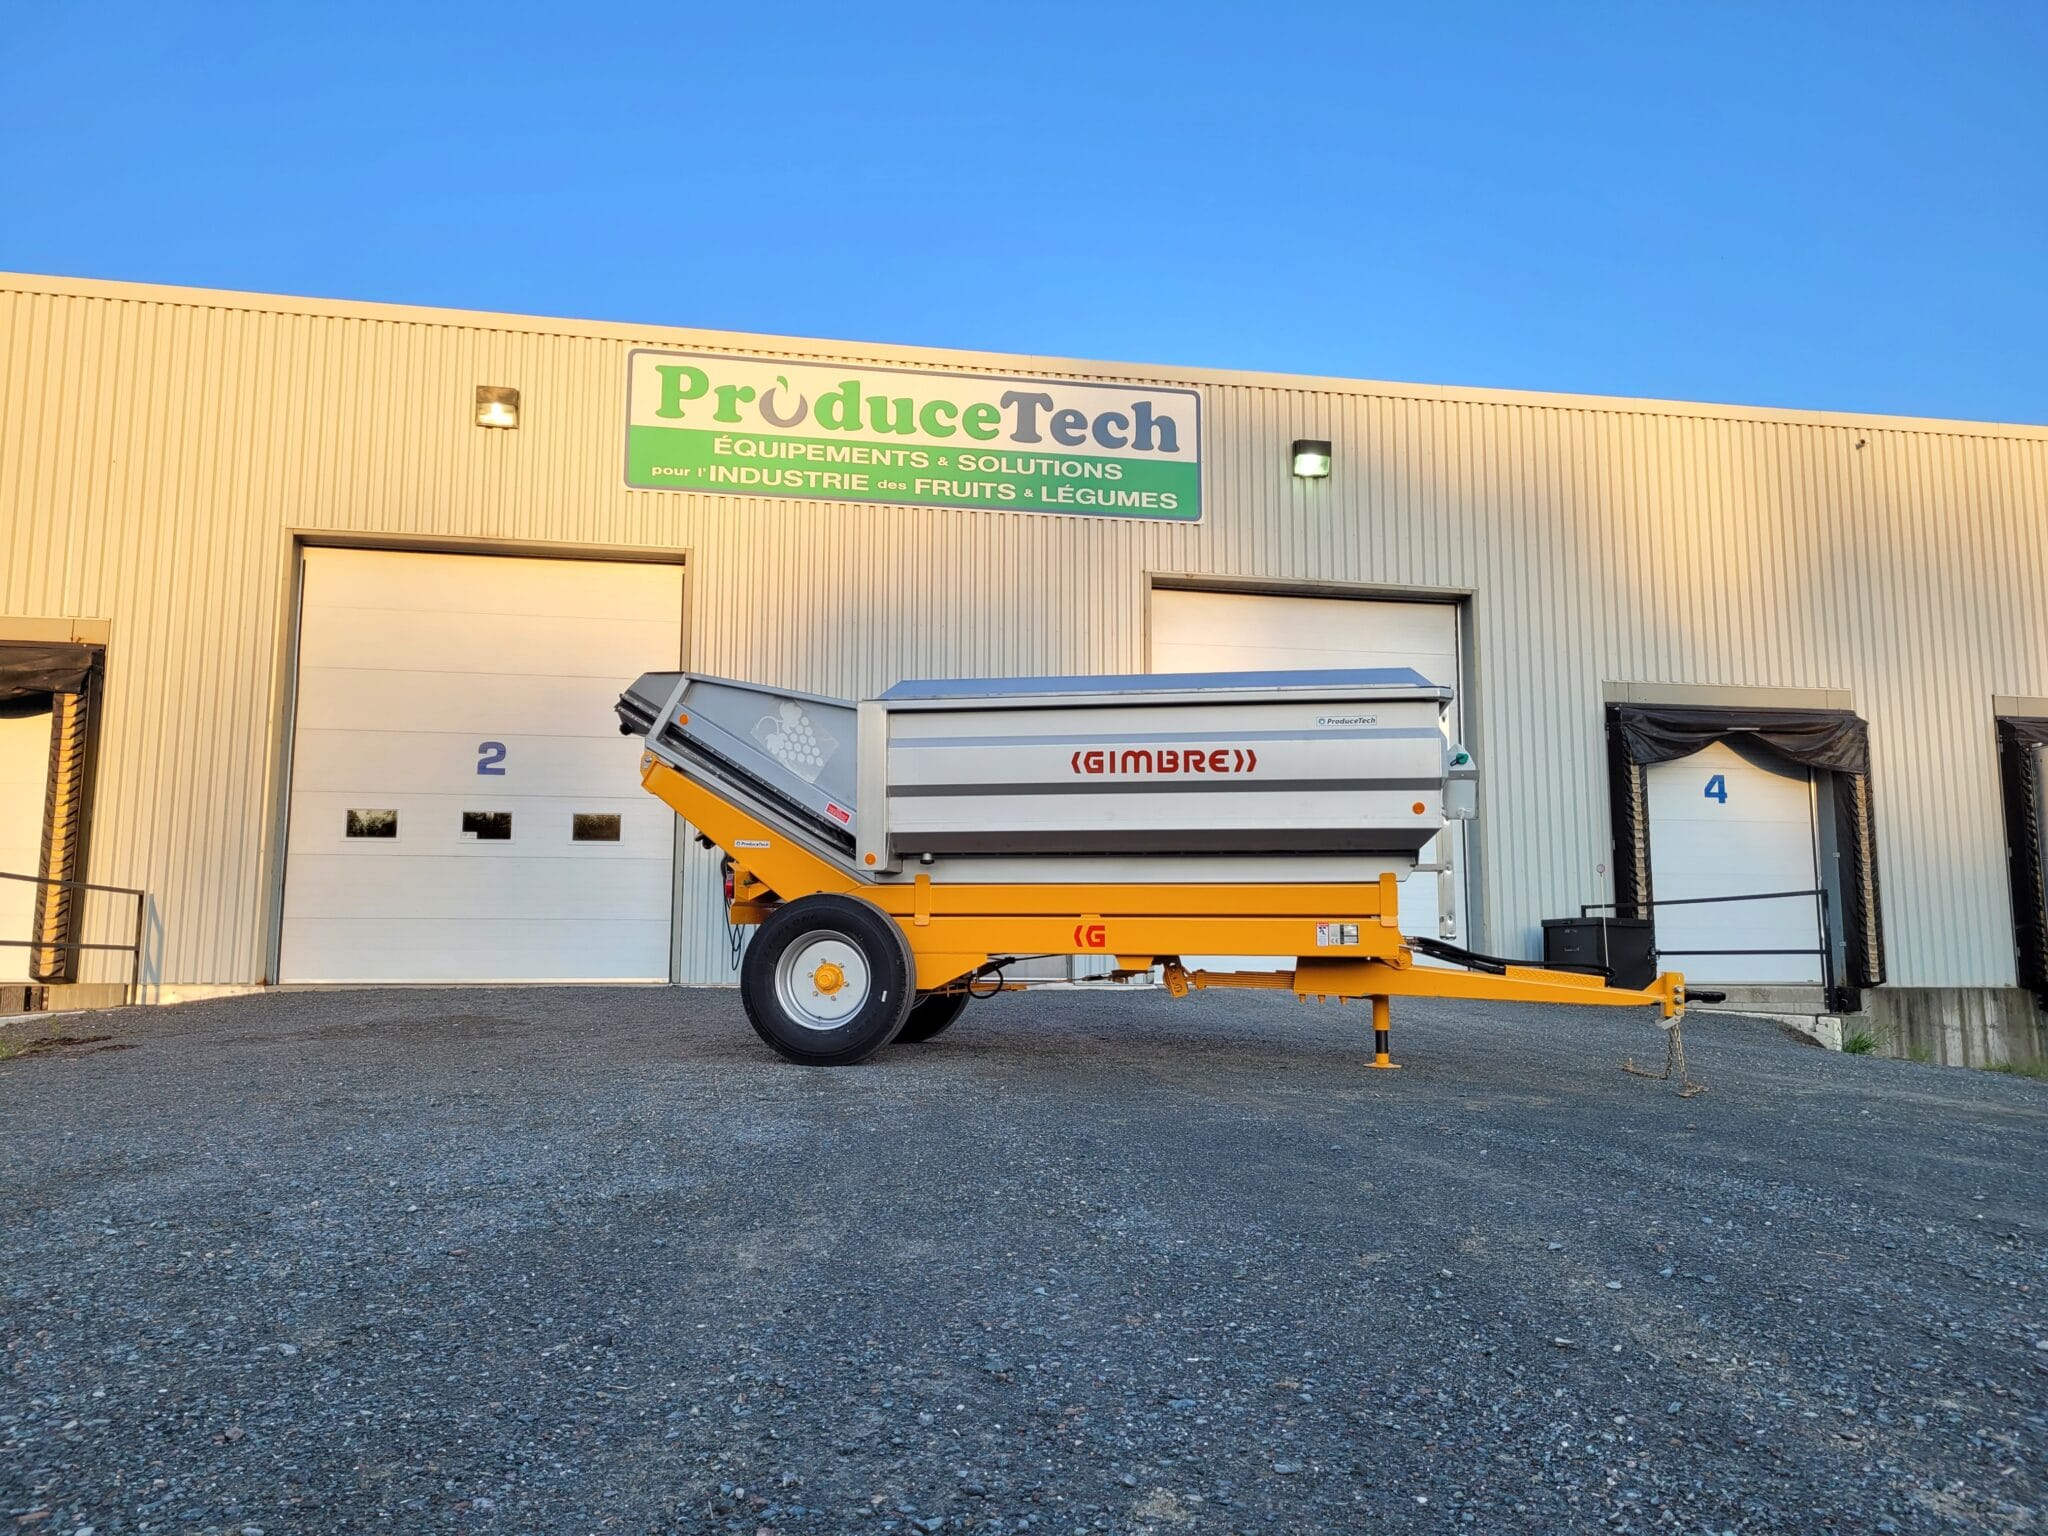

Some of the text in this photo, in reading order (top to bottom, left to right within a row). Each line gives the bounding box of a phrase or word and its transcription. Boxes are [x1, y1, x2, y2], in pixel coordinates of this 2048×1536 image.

[654, 364, 1181, 453] ProduceTech
[713, 435, 1123, 480] ÉQUIPEMENTS & SOLUTIONS
[651, 465, 691, 478] pour
[877, 479, 907, 490] des
[914, 478, 1017, 500] FRUITS
[1023, 488, 1034, 498] &
[1041, 484, 1179, 509] LÉGUMES
[1326, 716, 1376, 725] ProduceTech
[476, 741, 506, 775] 2
[1703, 774, 1729, 804] 4
